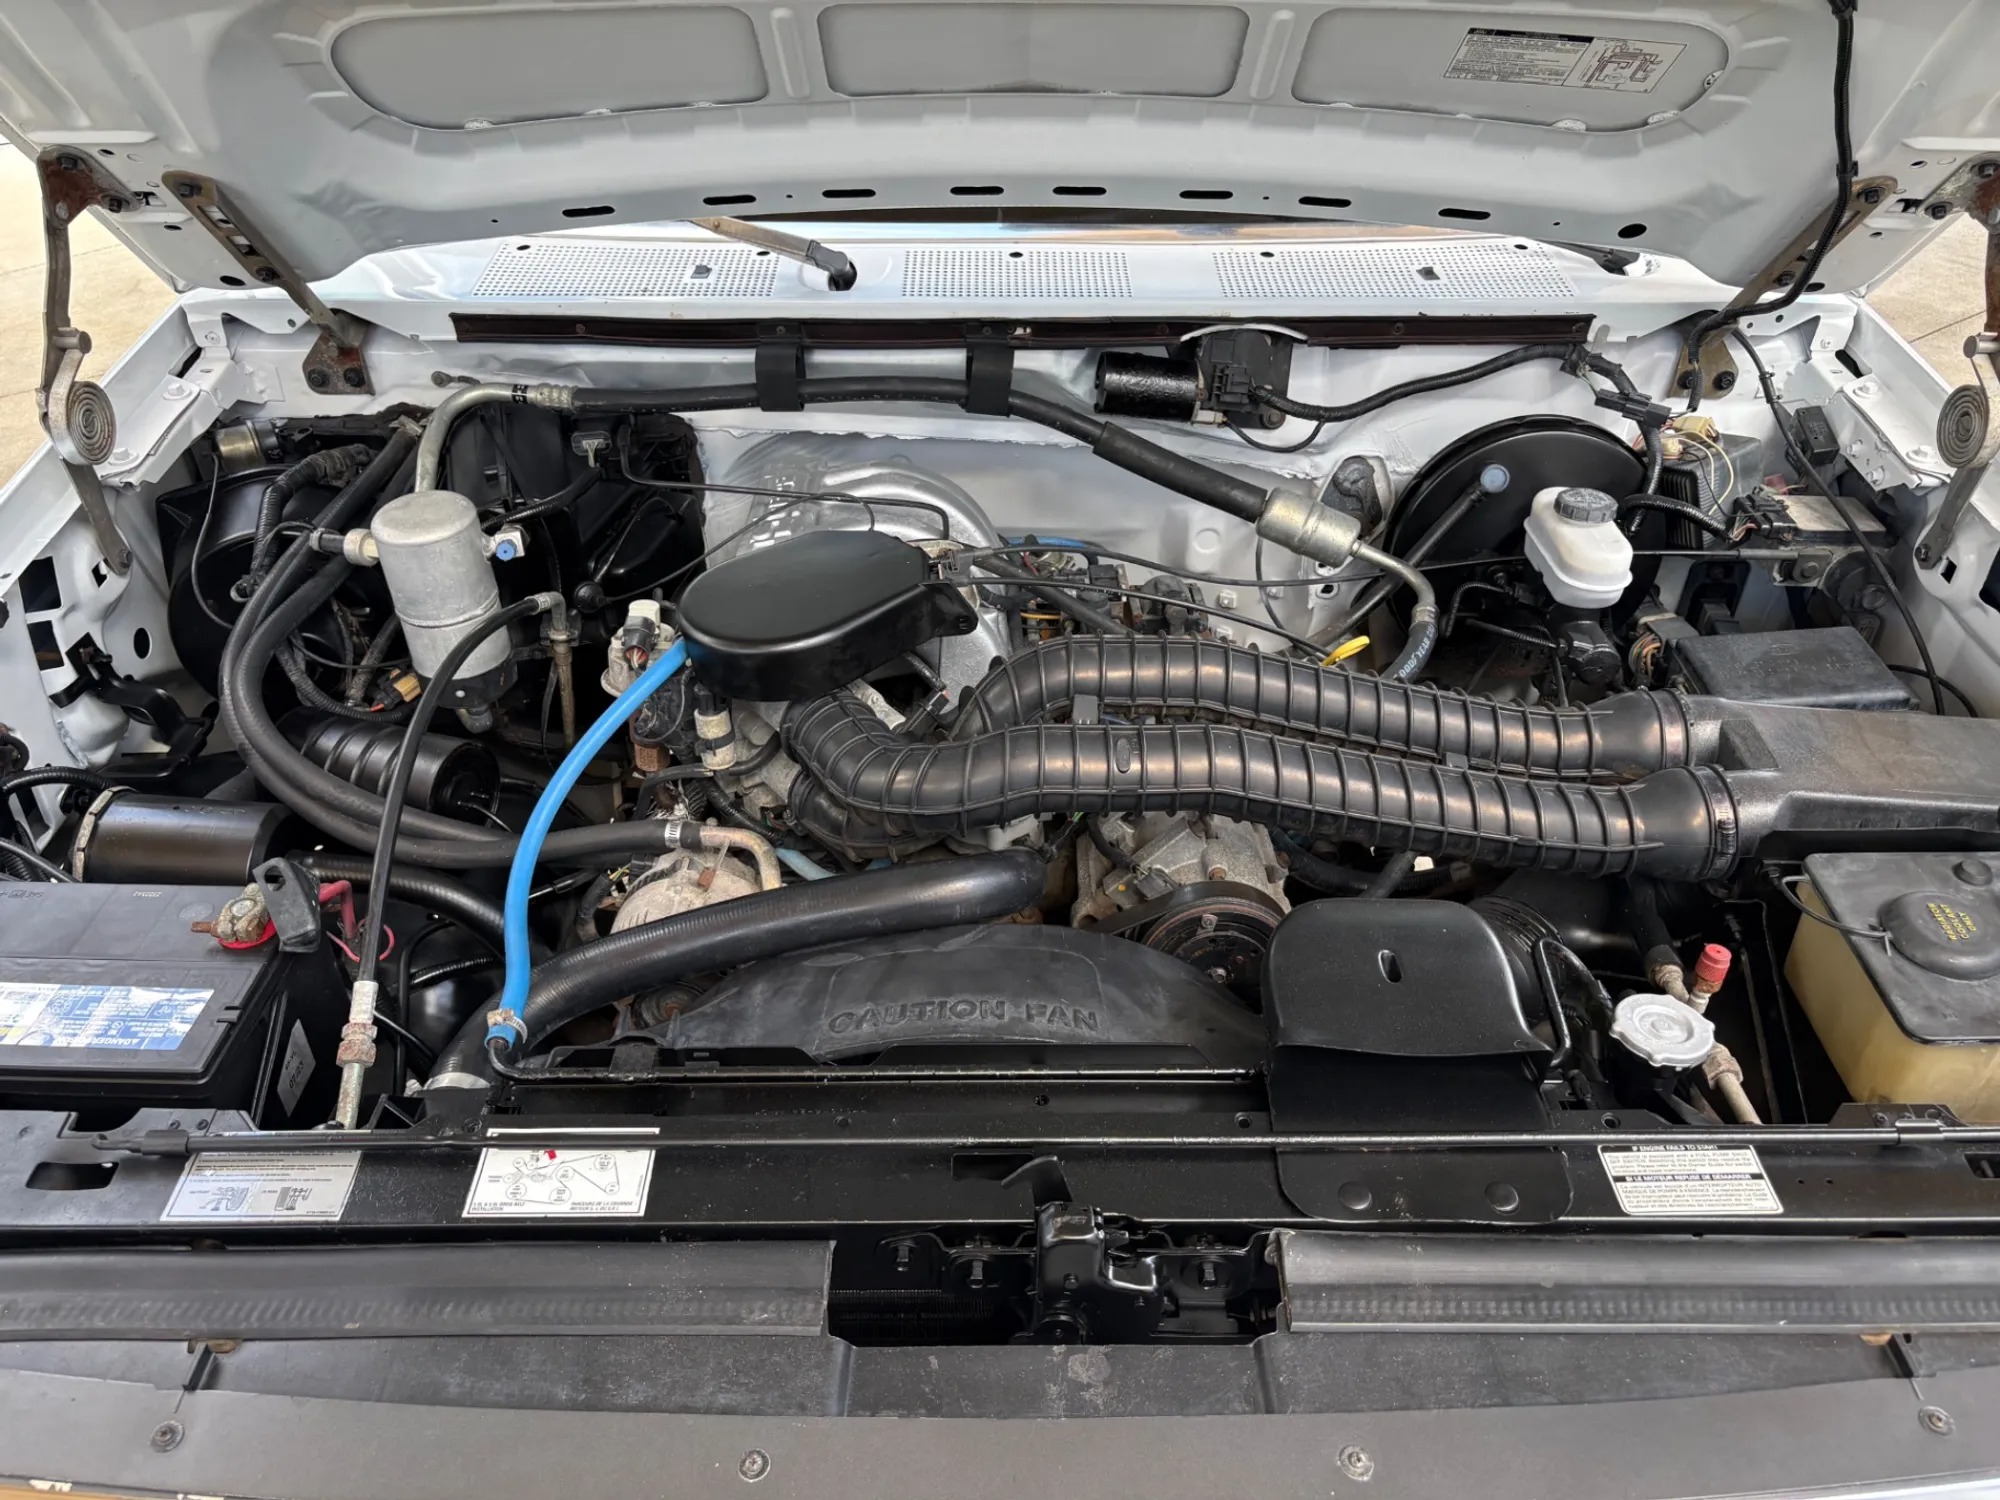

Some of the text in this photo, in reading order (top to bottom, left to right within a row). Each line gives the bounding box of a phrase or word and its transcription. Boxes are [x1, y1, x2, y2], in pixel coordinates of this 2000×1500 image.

[1927, 903, 1957, 940] RADIATOR
[1939, 904, 1969, 939] COOLANT
[1958, 912, 1976, 932] ONLY
[829, 998, 1100, 1033] CAUTION FAN
